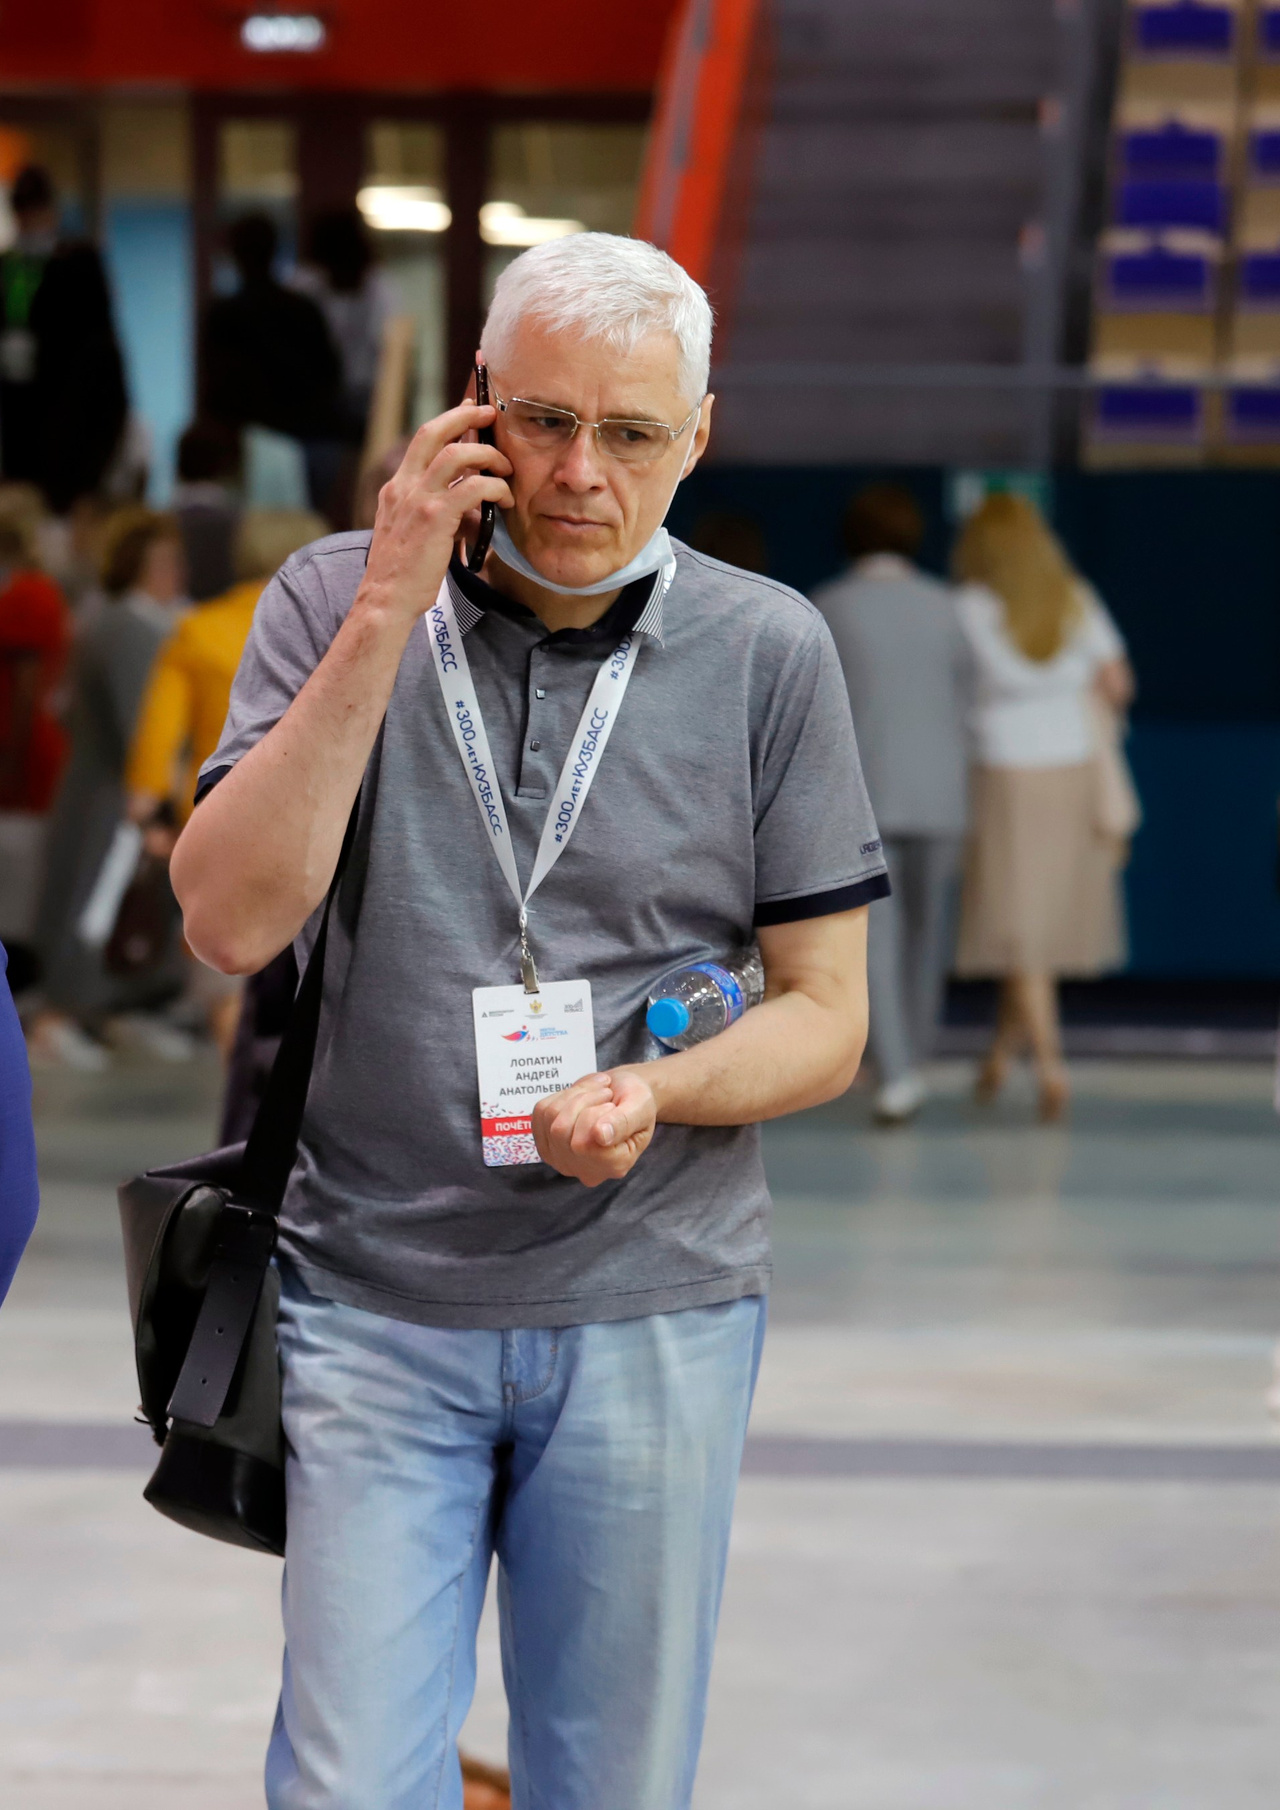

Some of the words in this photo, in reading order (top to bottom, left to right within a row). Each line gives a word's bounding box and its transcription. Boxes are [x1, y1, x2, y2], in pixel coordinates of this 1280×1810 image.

[510, 1055, 563, 1068] ЛОПАТИН
[515, 1067, 559, 1081] АНДРЕЙ
[499, 1082, 574, 1096] АНАТОЛЬЕВИ
[495, 1119, 531, 1132] ПОЧЁТ
